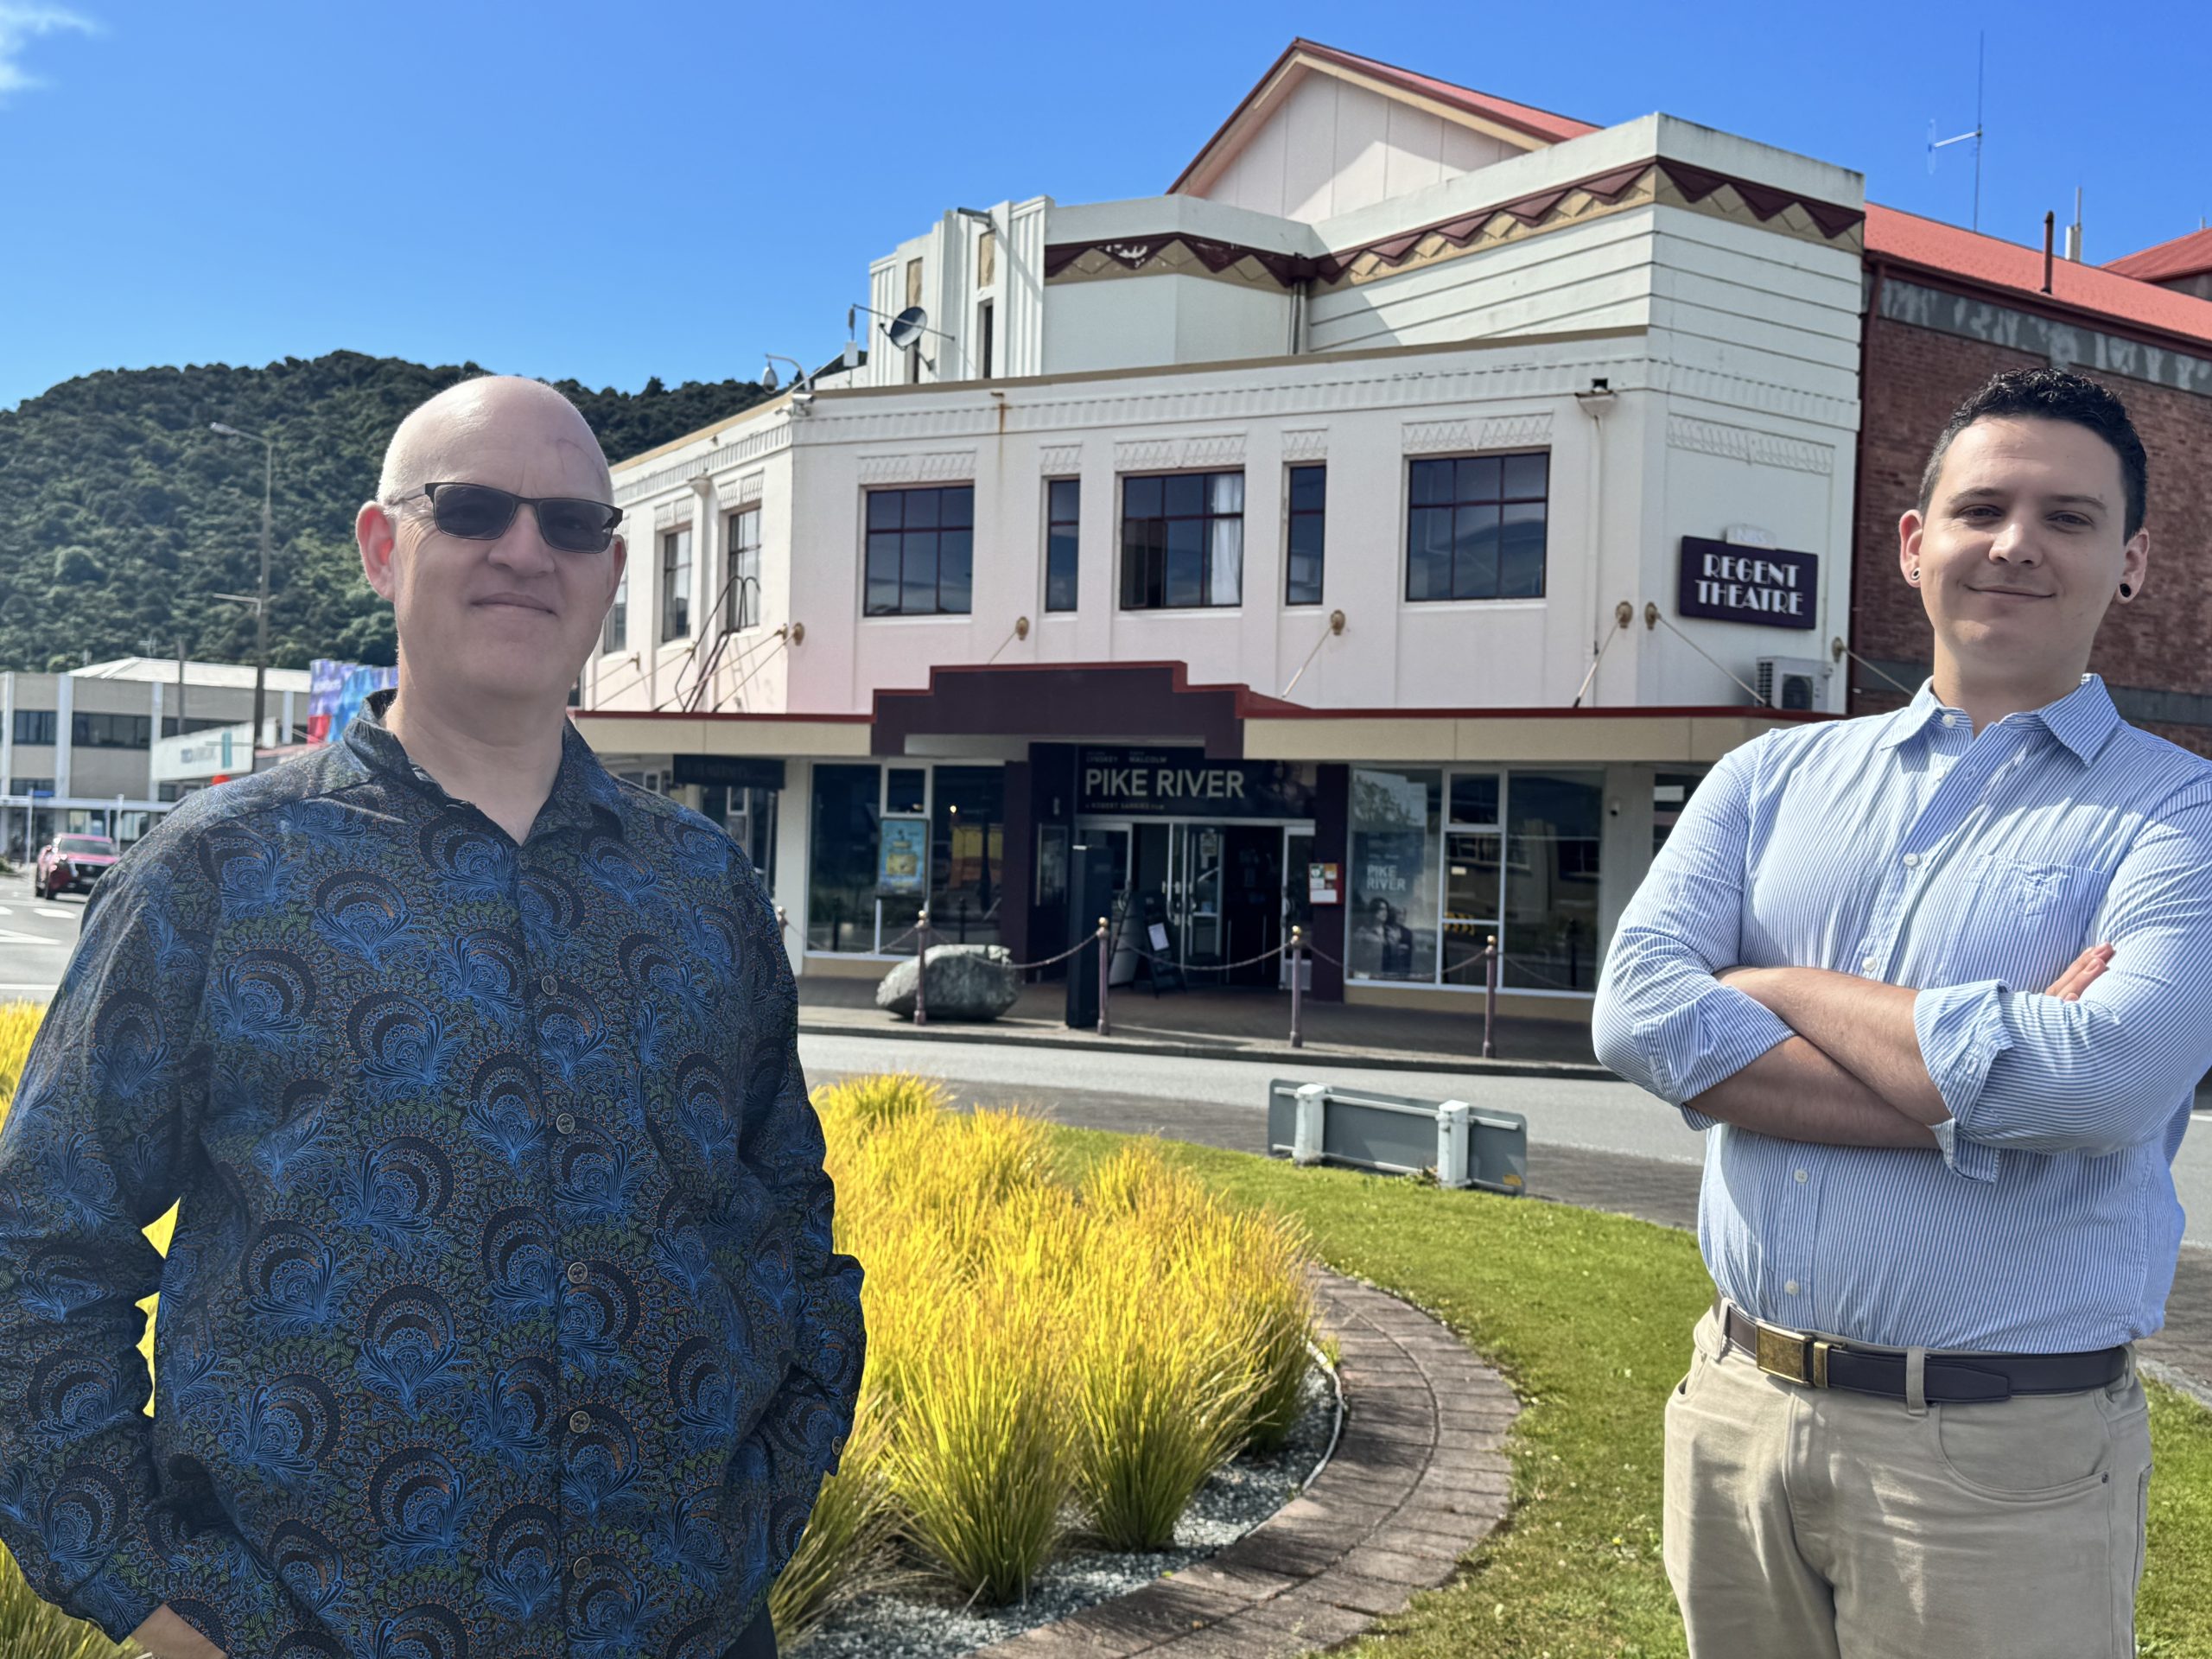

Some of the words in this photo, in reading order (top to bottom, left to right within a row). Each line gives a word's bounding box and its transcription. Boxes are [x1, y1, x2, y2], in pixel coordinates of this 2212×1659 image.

[1703, 553, 1800, 588] REGENT
[1694, 580, 1803, 615] THEATRE
[1085, 768, 1147, 796] PIKE
[1156, 769, 1244, 798] RIVER
[1367, 865, 1397, 877] PIKE
[1367, 877, 1406, 891] RIVER
